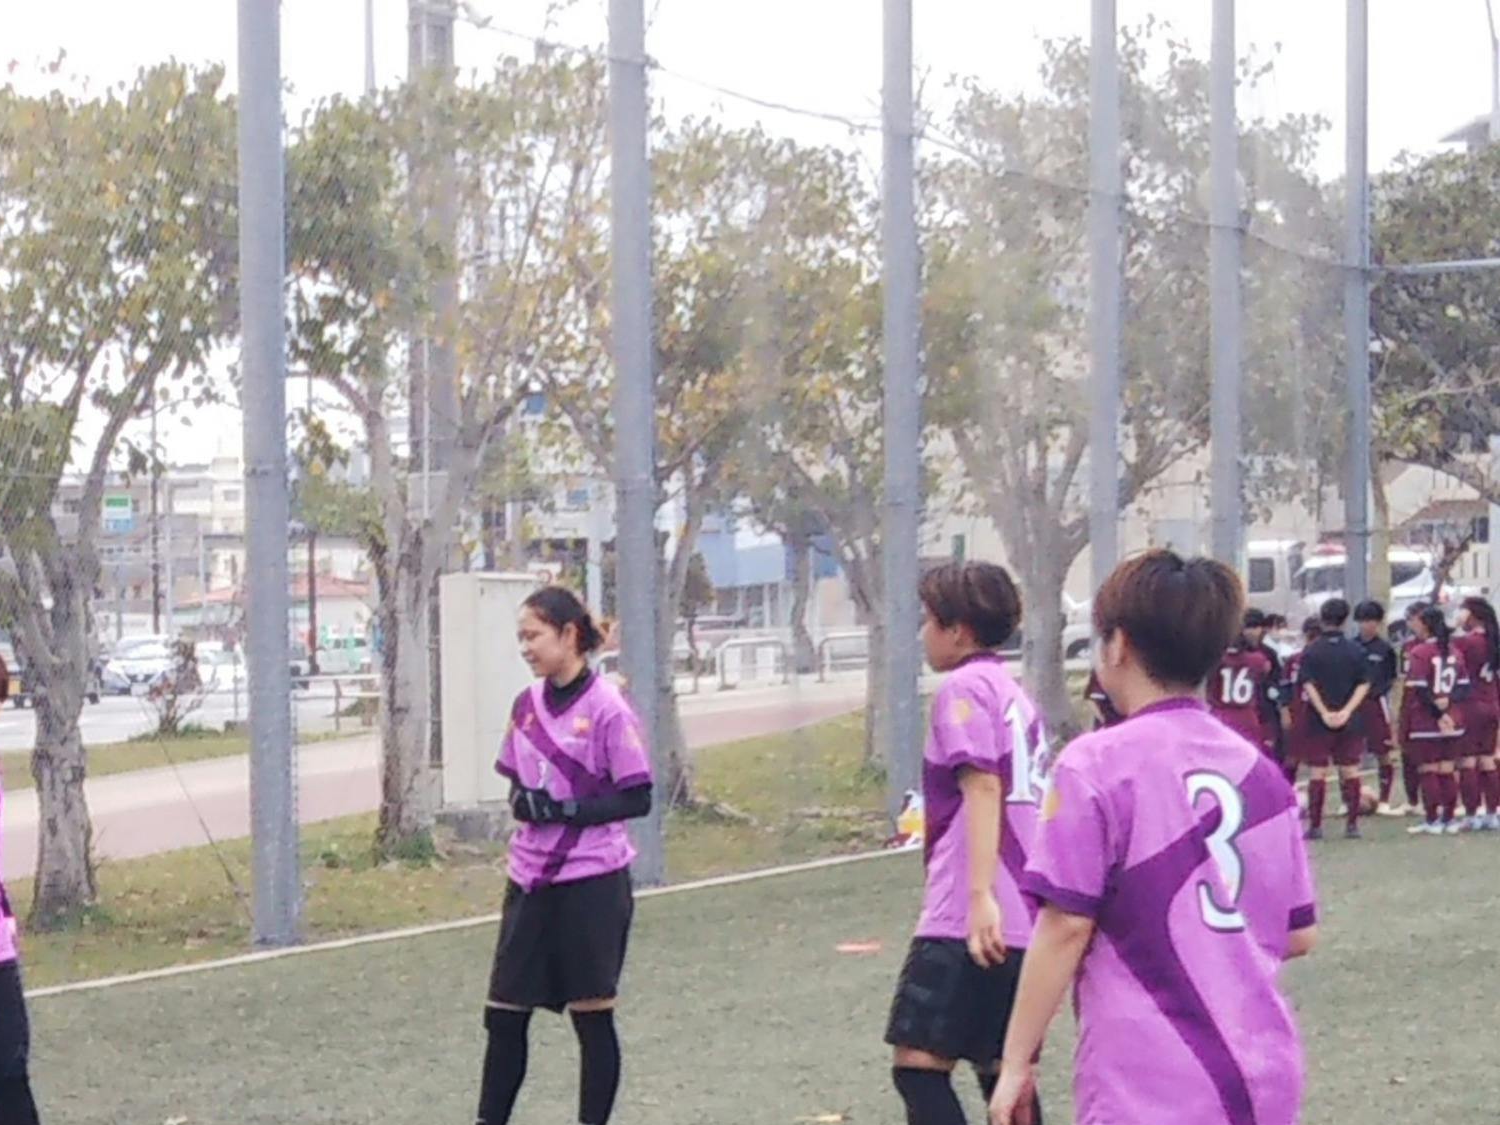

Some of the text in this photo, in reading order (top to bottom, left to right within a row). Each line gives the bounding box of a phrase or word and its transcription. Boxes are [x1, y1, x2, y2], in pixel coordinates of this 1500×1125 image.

[1220, 666, 1254, 704] 16
[1431, 655, 1457, 693] 15
[1181, 768, 1246, 934] 3
